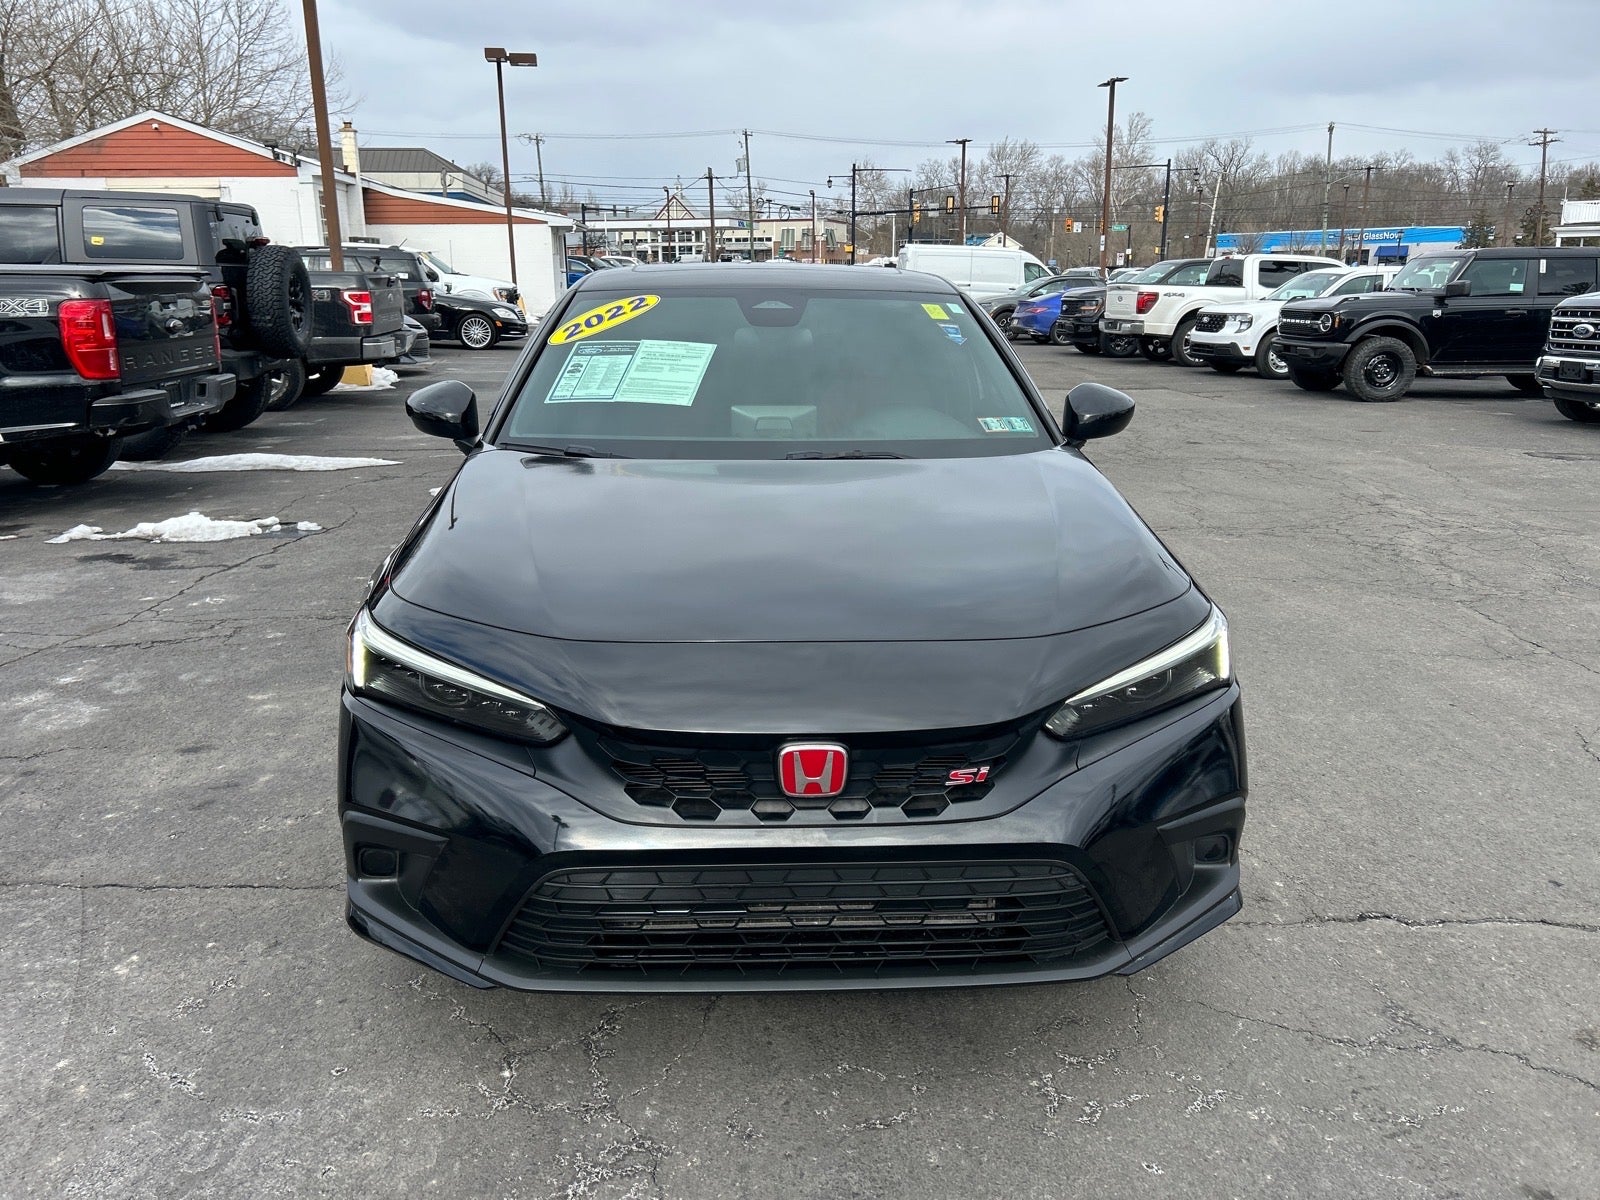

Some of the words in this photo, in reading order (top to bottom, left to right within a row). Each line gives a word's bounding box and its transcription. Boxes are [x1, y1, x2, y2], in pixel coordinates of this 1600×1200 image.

[0, 298, 50, 313] X4
[562, 297, 649, 341] 2022
[124, 345, 215, 370] RANGER
[945, 766, 991, 786] Si
